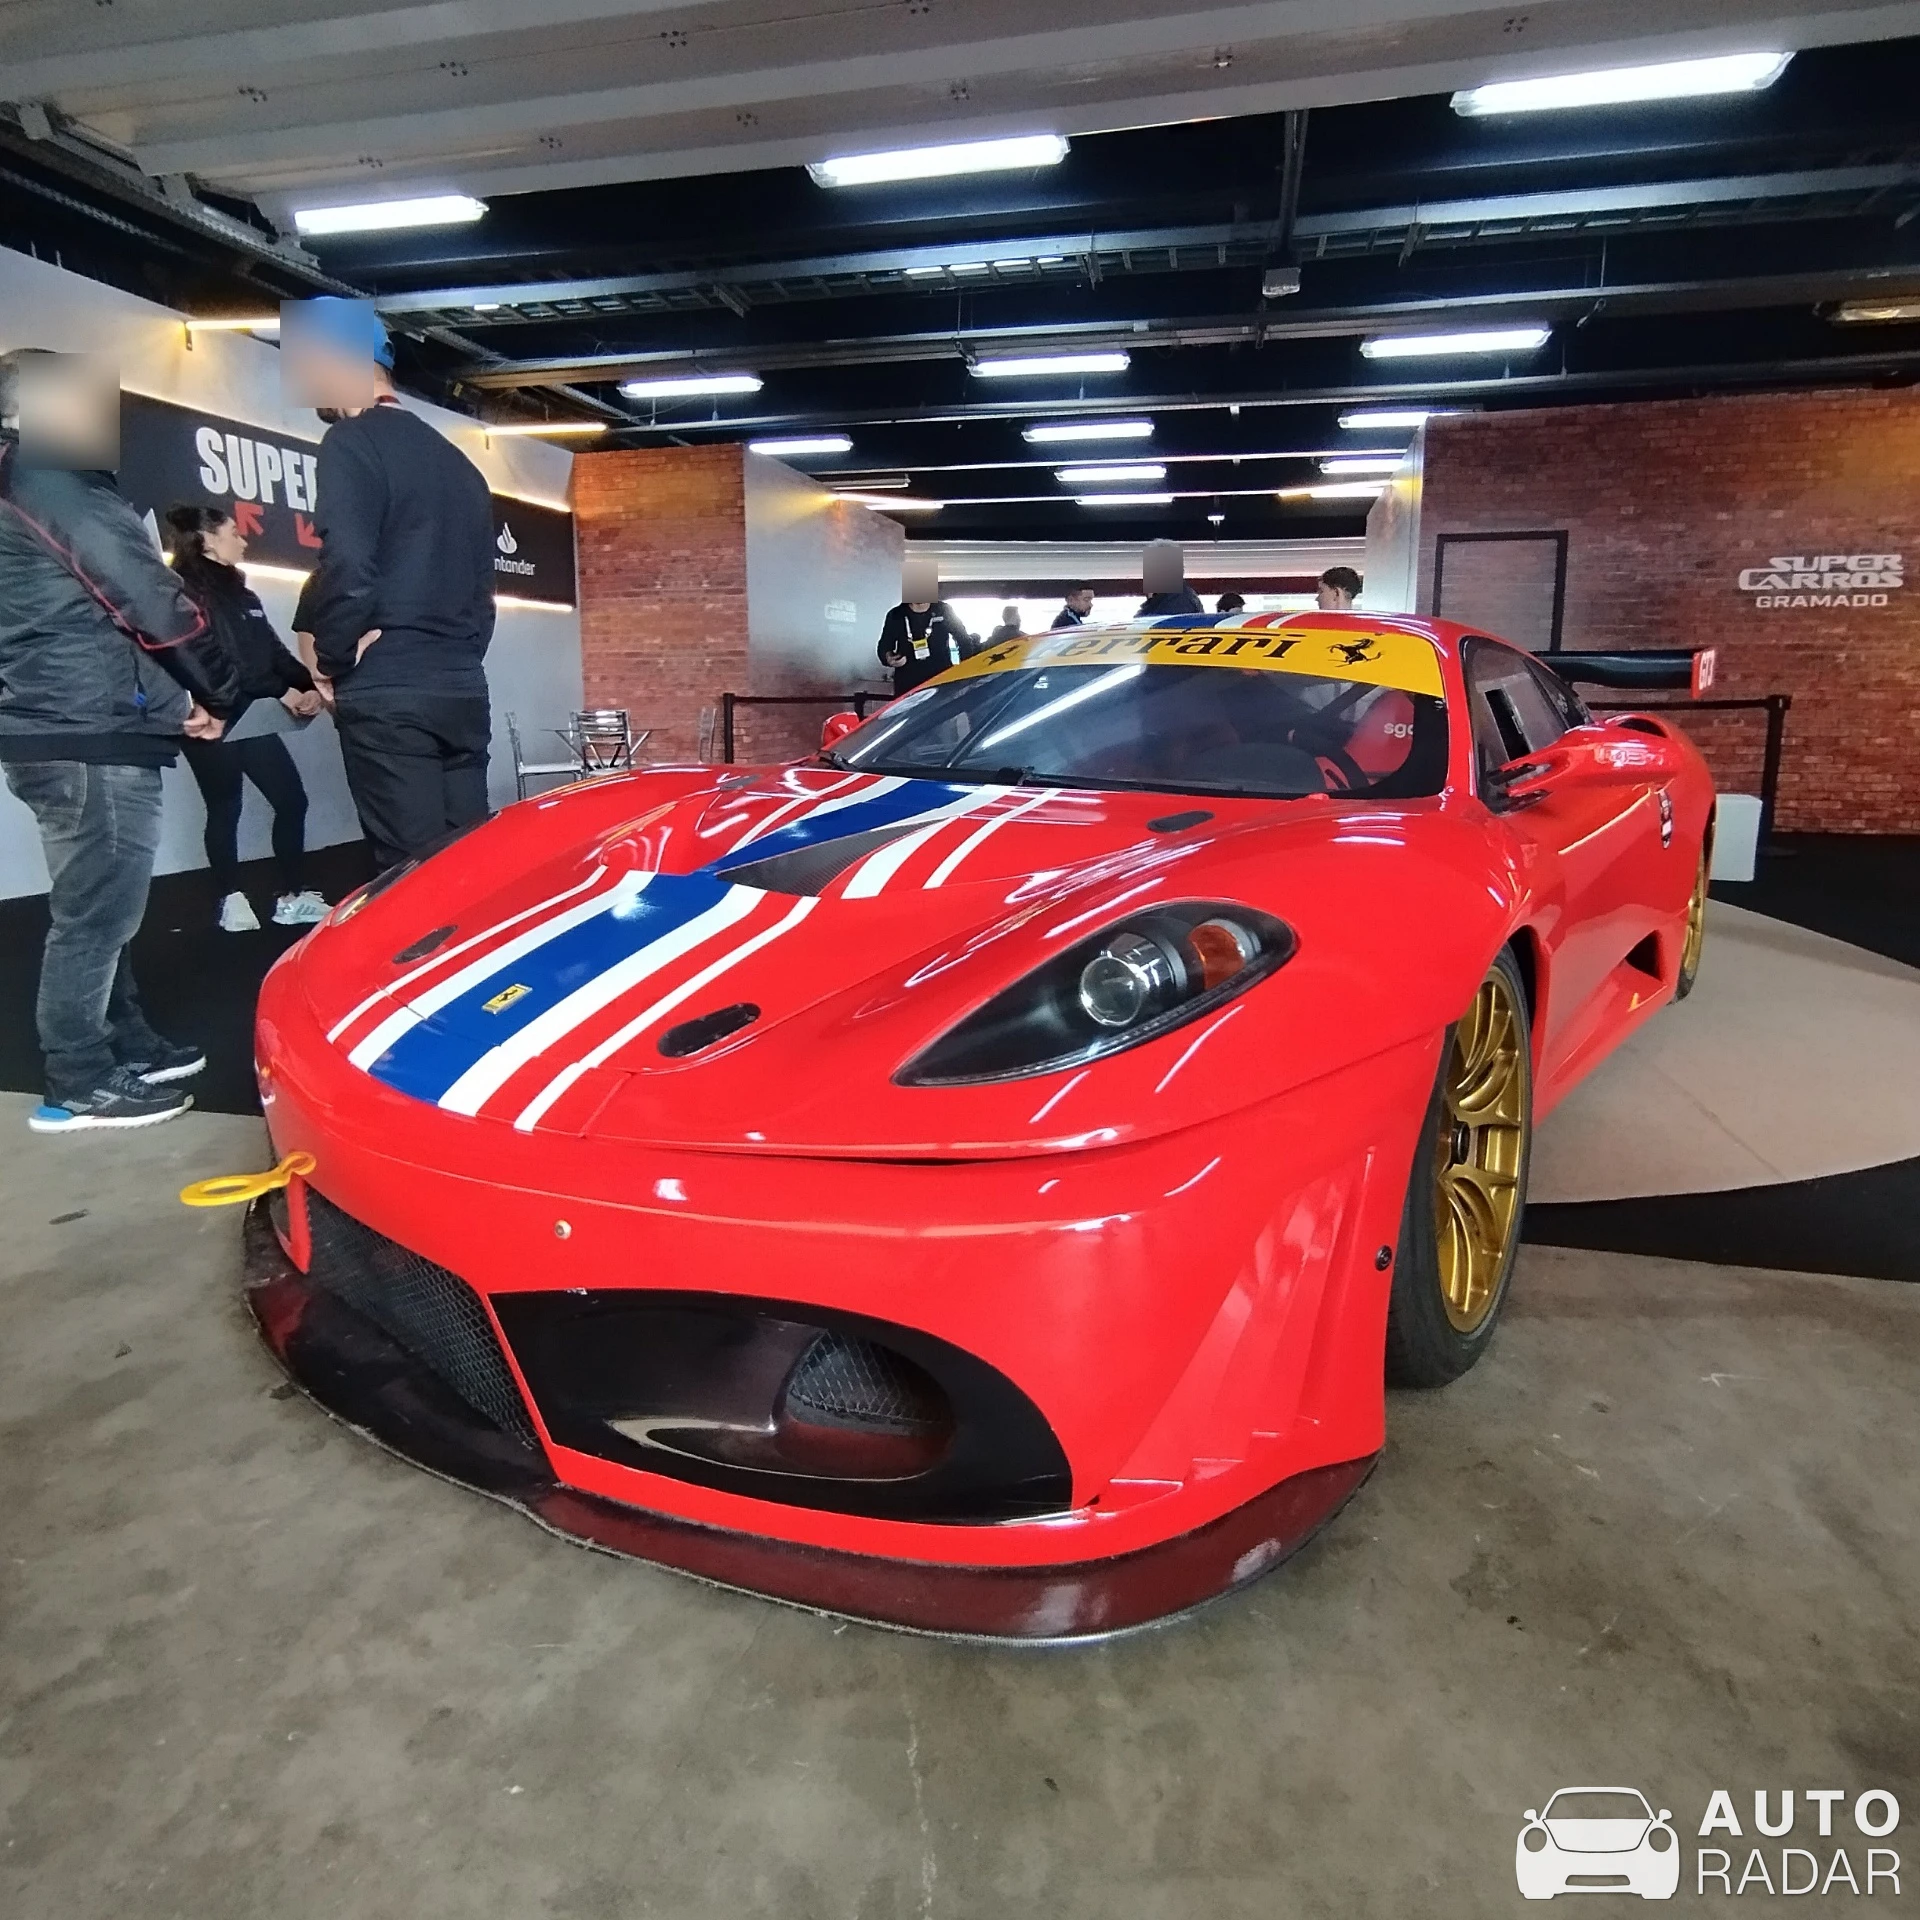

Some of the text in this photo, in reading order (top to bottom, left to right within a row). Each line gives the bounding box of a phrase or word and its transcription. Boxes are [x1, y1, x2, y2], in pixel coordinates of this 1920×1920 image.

[1769, 554, 1904, 572] SUPER
[1738, 568, 1904, 591] CARROS
[1755, 593, 1889, 609] GRAMADO
[1021, 630, 1308, 660] Ferrari
